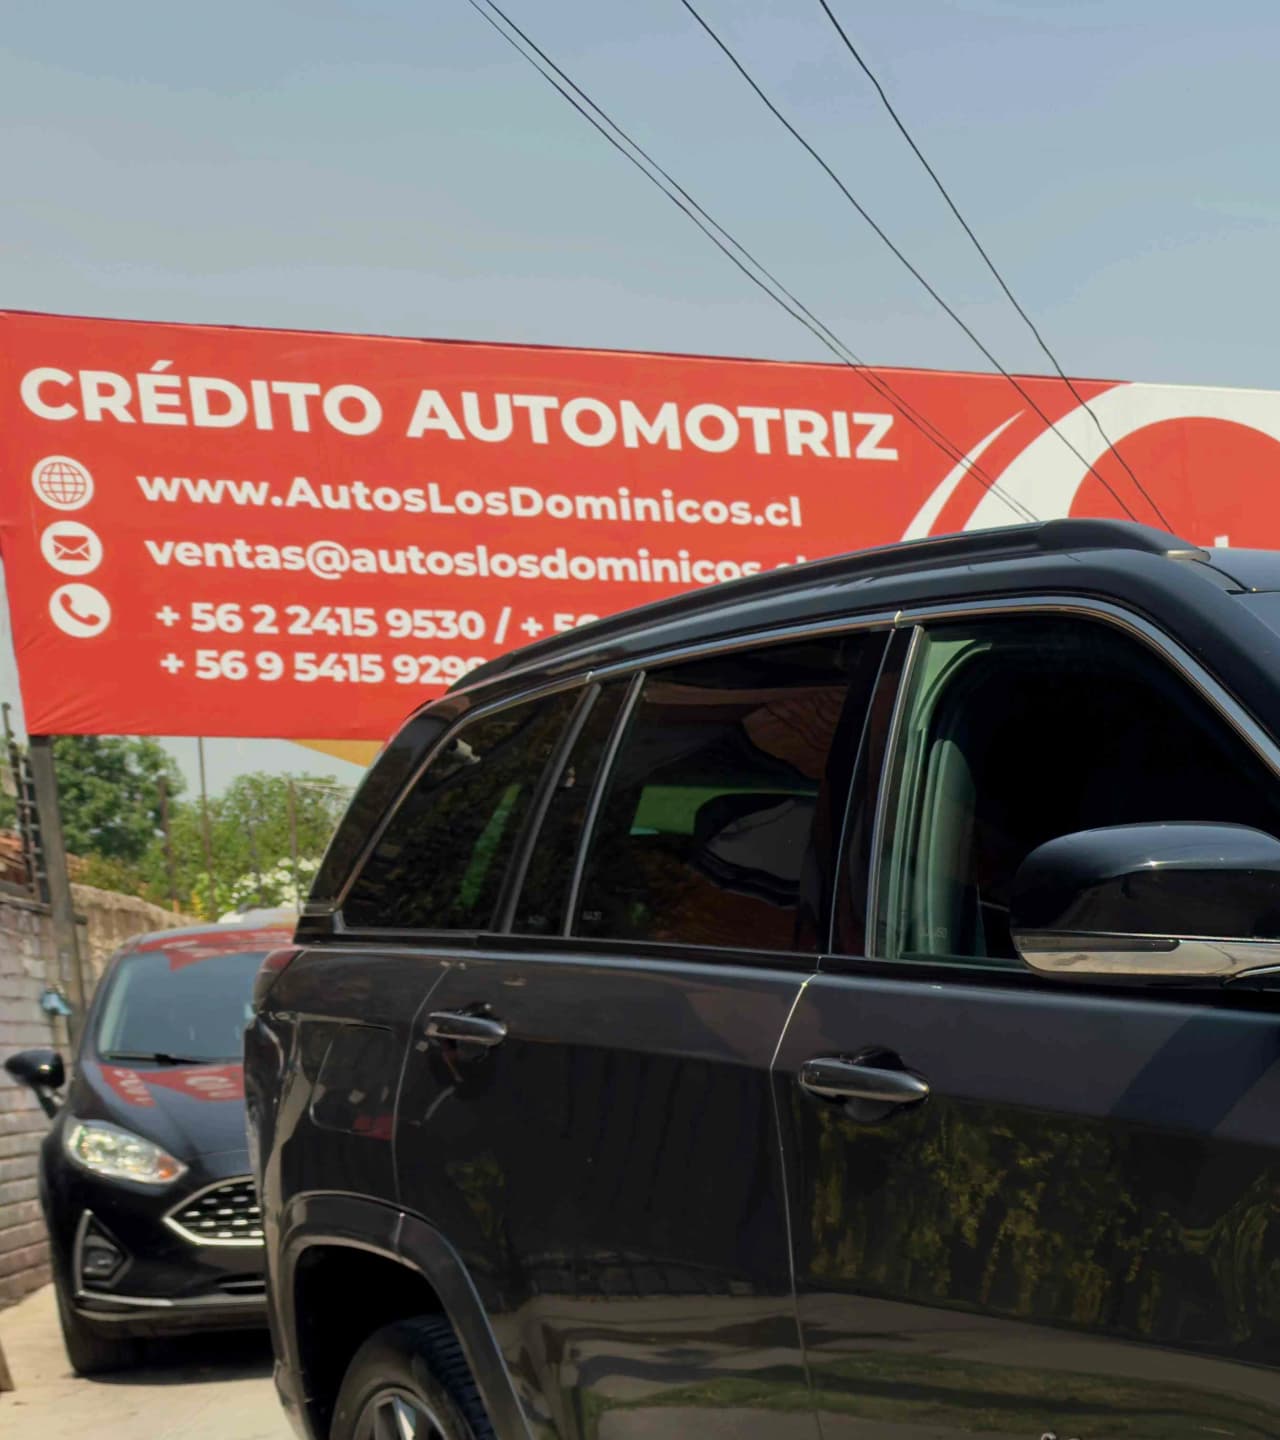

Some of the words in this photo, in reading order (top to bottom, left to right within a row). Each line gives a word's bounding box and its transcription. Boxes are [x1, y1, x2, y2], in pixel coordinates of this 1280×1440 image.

[20, 360, 383, 436] CRÉDITO
[406, 390, 899, 461] AUTOMOTRIZ
[136, 475, 802, 527] www.AutosLosDominicos.cl
[190, 602, 245, 634] 56
[251, 604, 280, 635] 2
[286, 605, 378, 638] 2415
[385, 607, 486, 640] 9530
[194, 649, 248, 681] 56
[254, 650, 284, 682] 9
[293, 651, 385, 684] 5415
